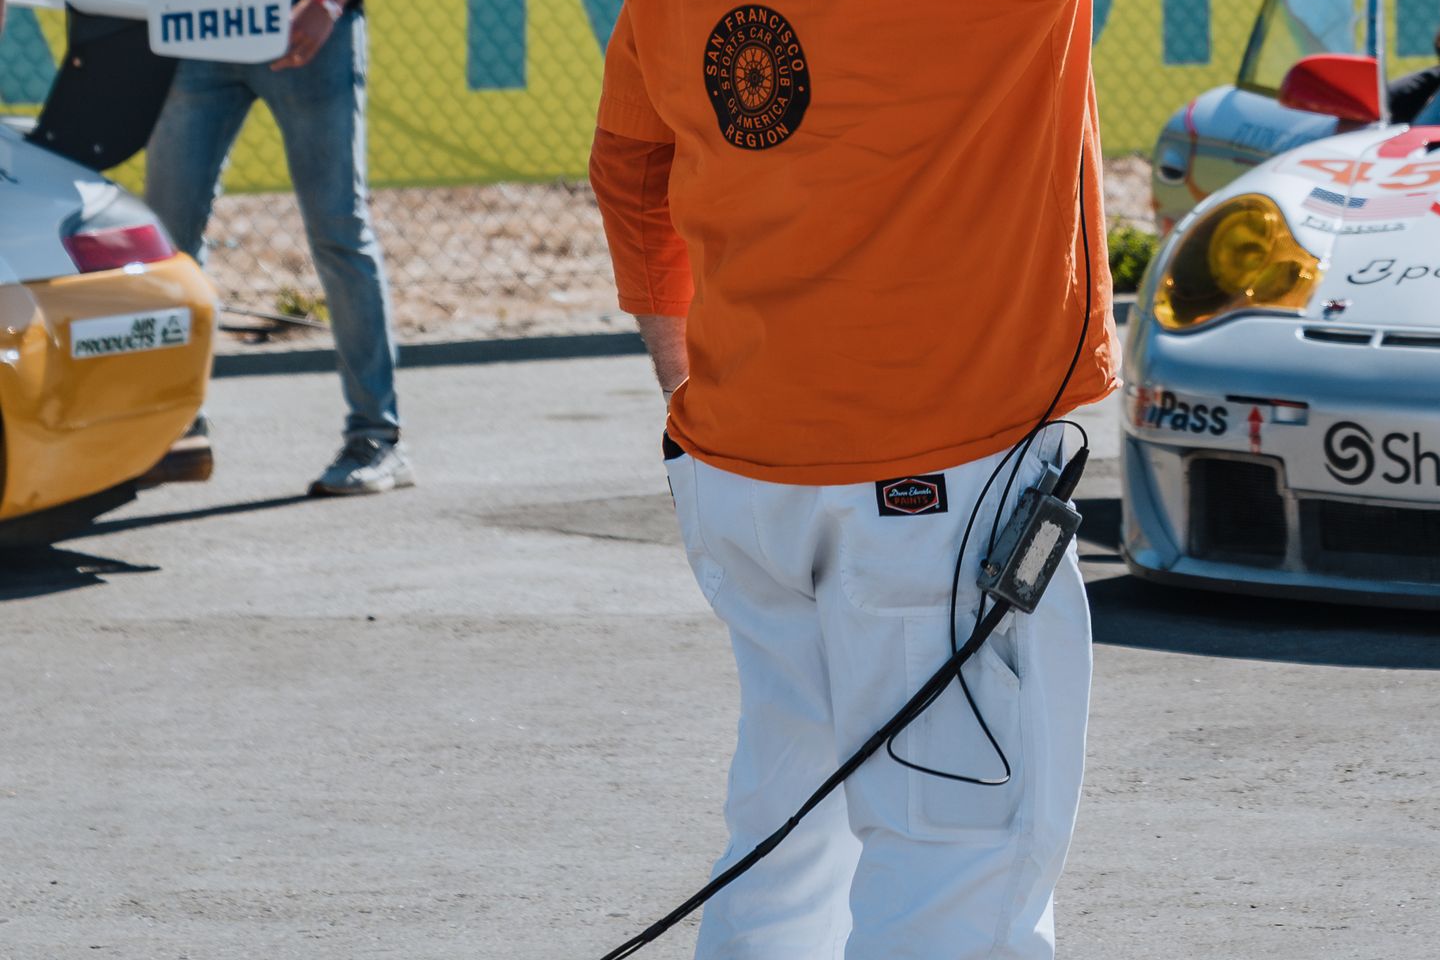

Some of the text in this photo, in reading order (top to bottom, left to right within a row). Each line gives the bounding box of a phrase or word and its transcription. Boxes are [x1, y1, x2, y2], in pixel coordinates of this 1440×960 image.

[161, 3, 281, 43] MAHLE
[706, 8, 805, 76] SAN FRANCISCO
[720, 26, 791, 91] SPORTS CAR CLUB
[727, 96, 789, 130] OF AMERICA
[725, 122, 790, 148] REGION
[74, 334, 155, 355] PRODUCTS
